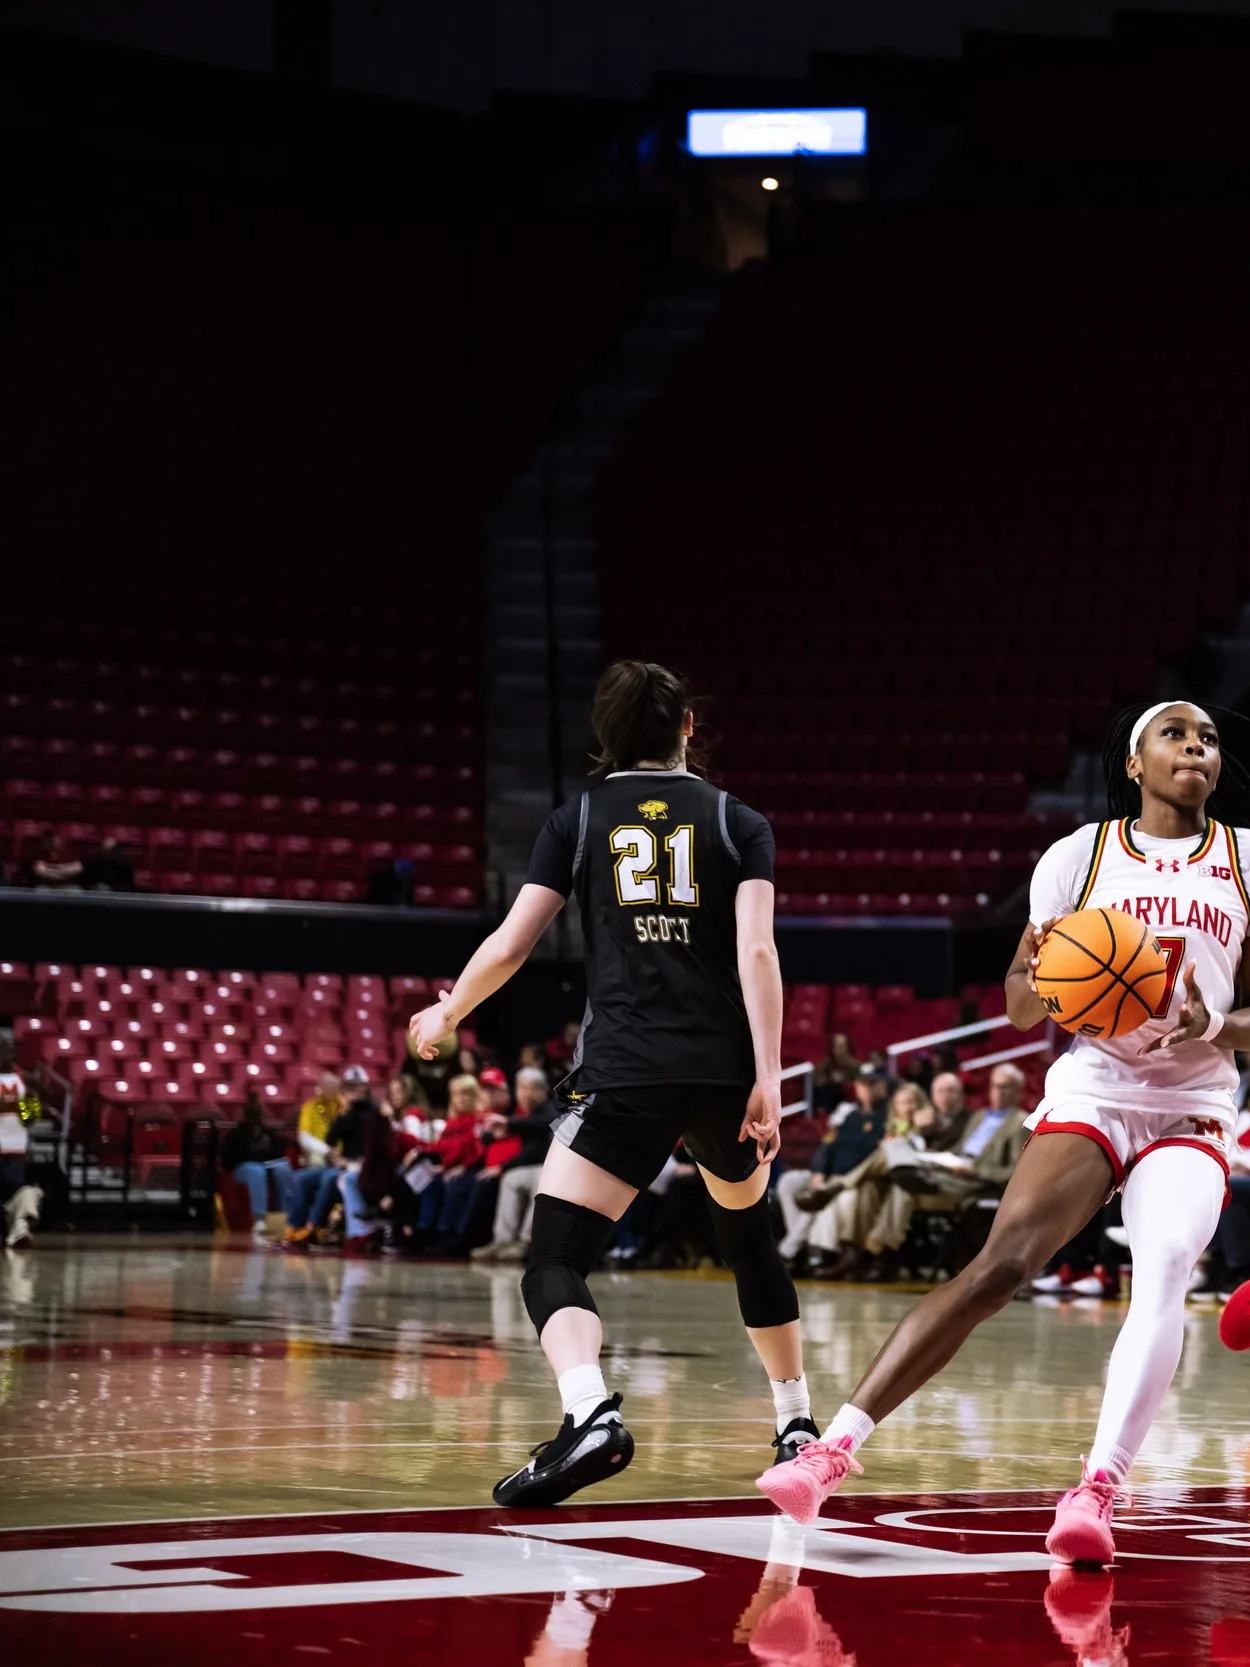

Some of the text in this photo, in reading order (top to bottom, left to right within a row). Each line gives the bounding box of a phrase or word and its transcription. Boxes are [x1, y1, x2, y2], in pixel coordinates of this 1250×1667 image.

[609, 824, 700, 907] 21
[634, 913, 691, 945] SCOTT
[1112, 896, 1233, 948] ARYLAND
